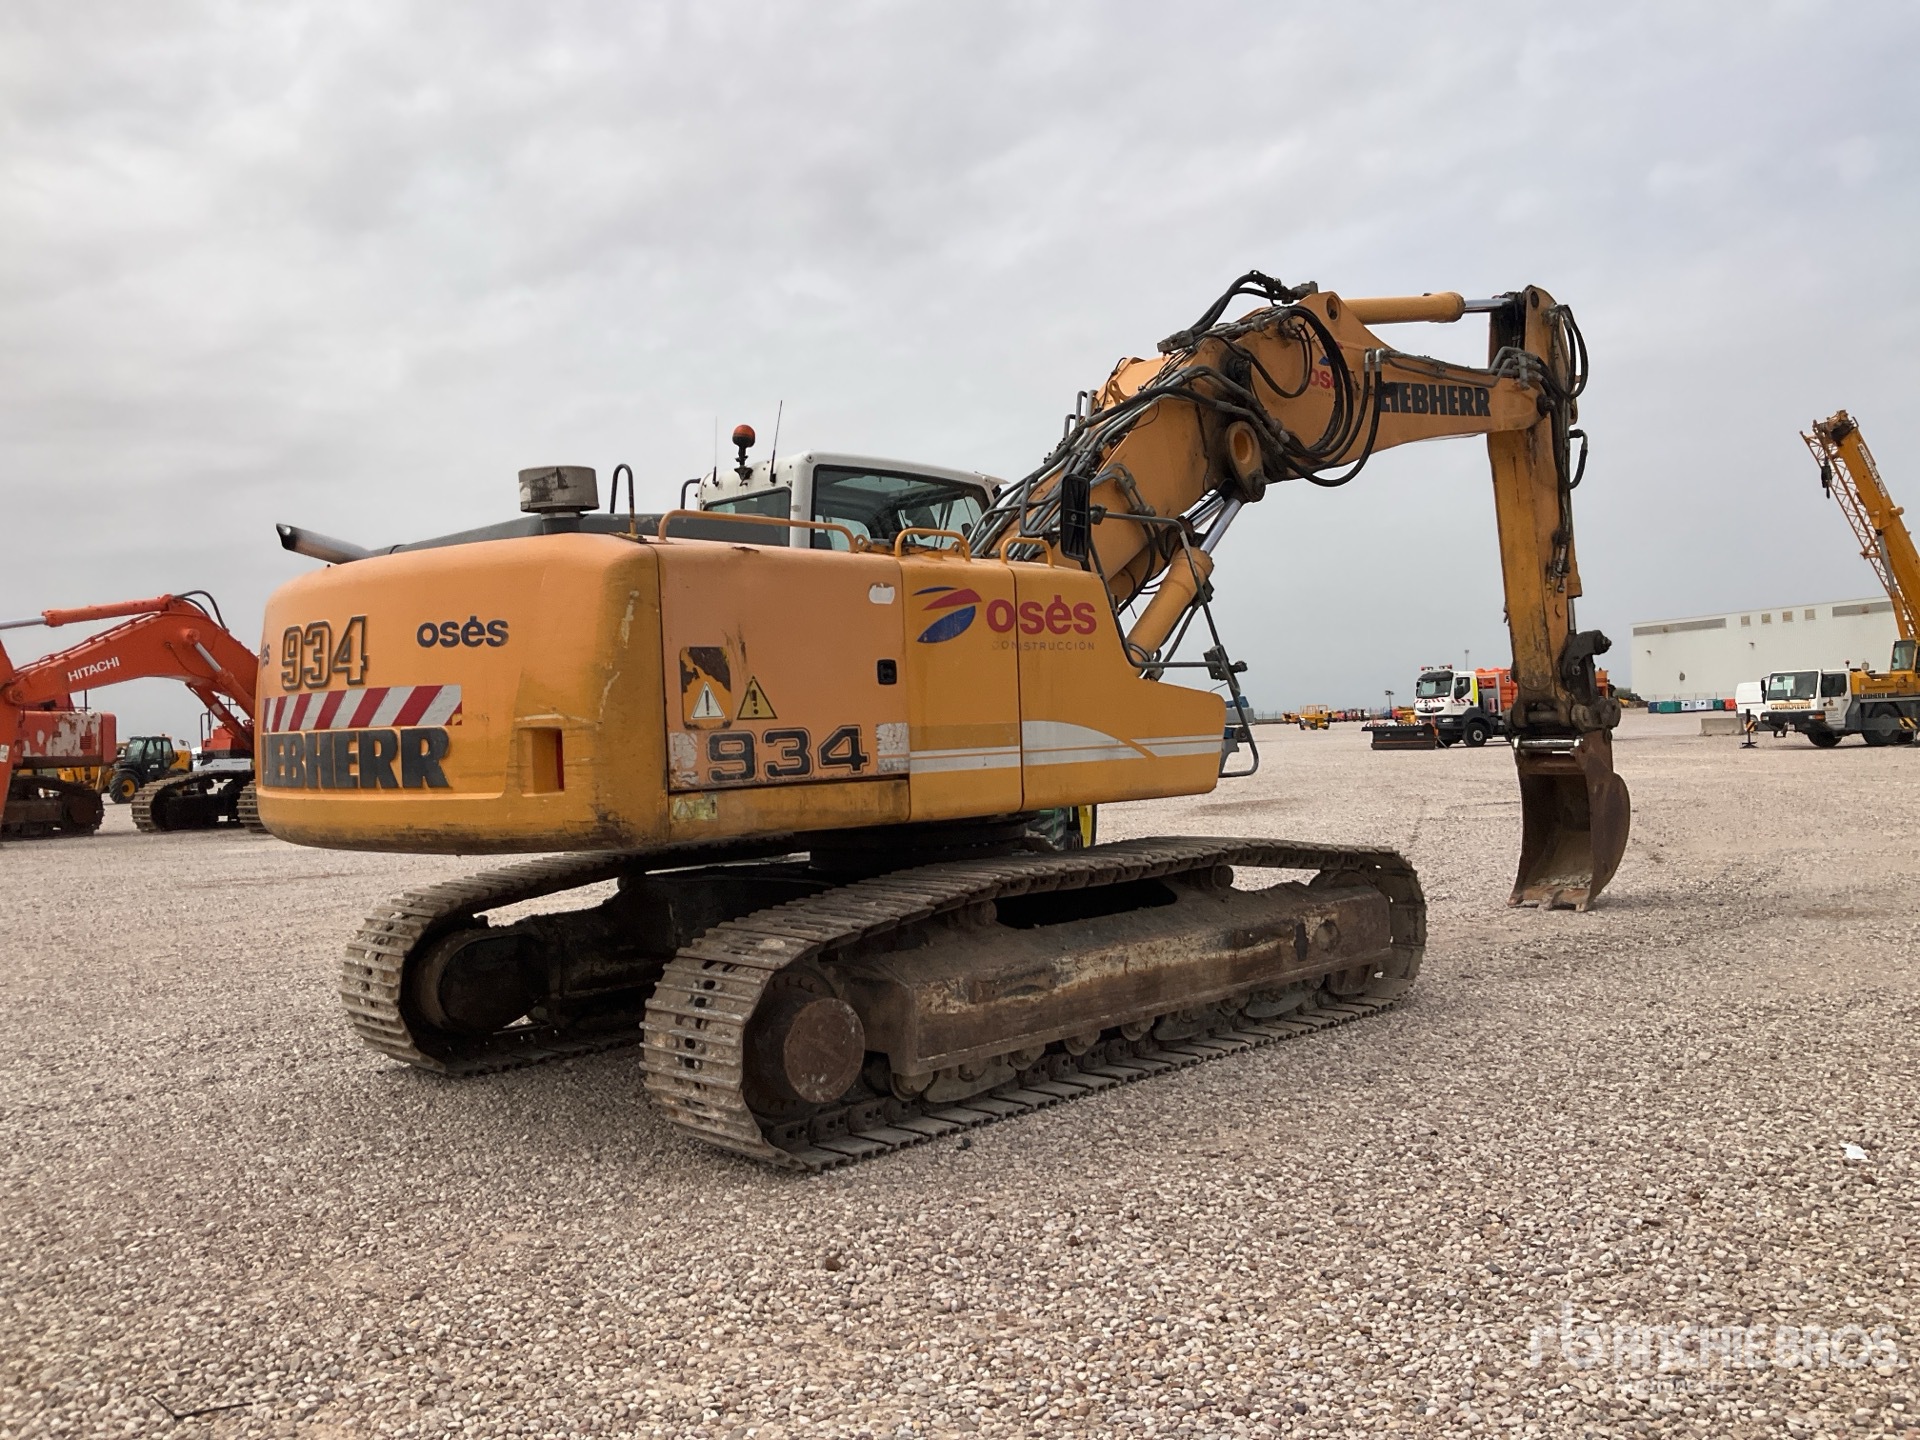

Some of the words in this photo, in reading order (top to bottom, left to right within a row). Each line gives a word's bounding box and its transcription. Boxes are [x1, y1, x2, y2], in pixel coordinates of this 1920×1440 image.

[67, 656, 120, 682] HITACHI
[281, 614, 368, 691] 934
[261, 727, 451, 789] LIEBHERR
[707, 724, 870, 783] 934
